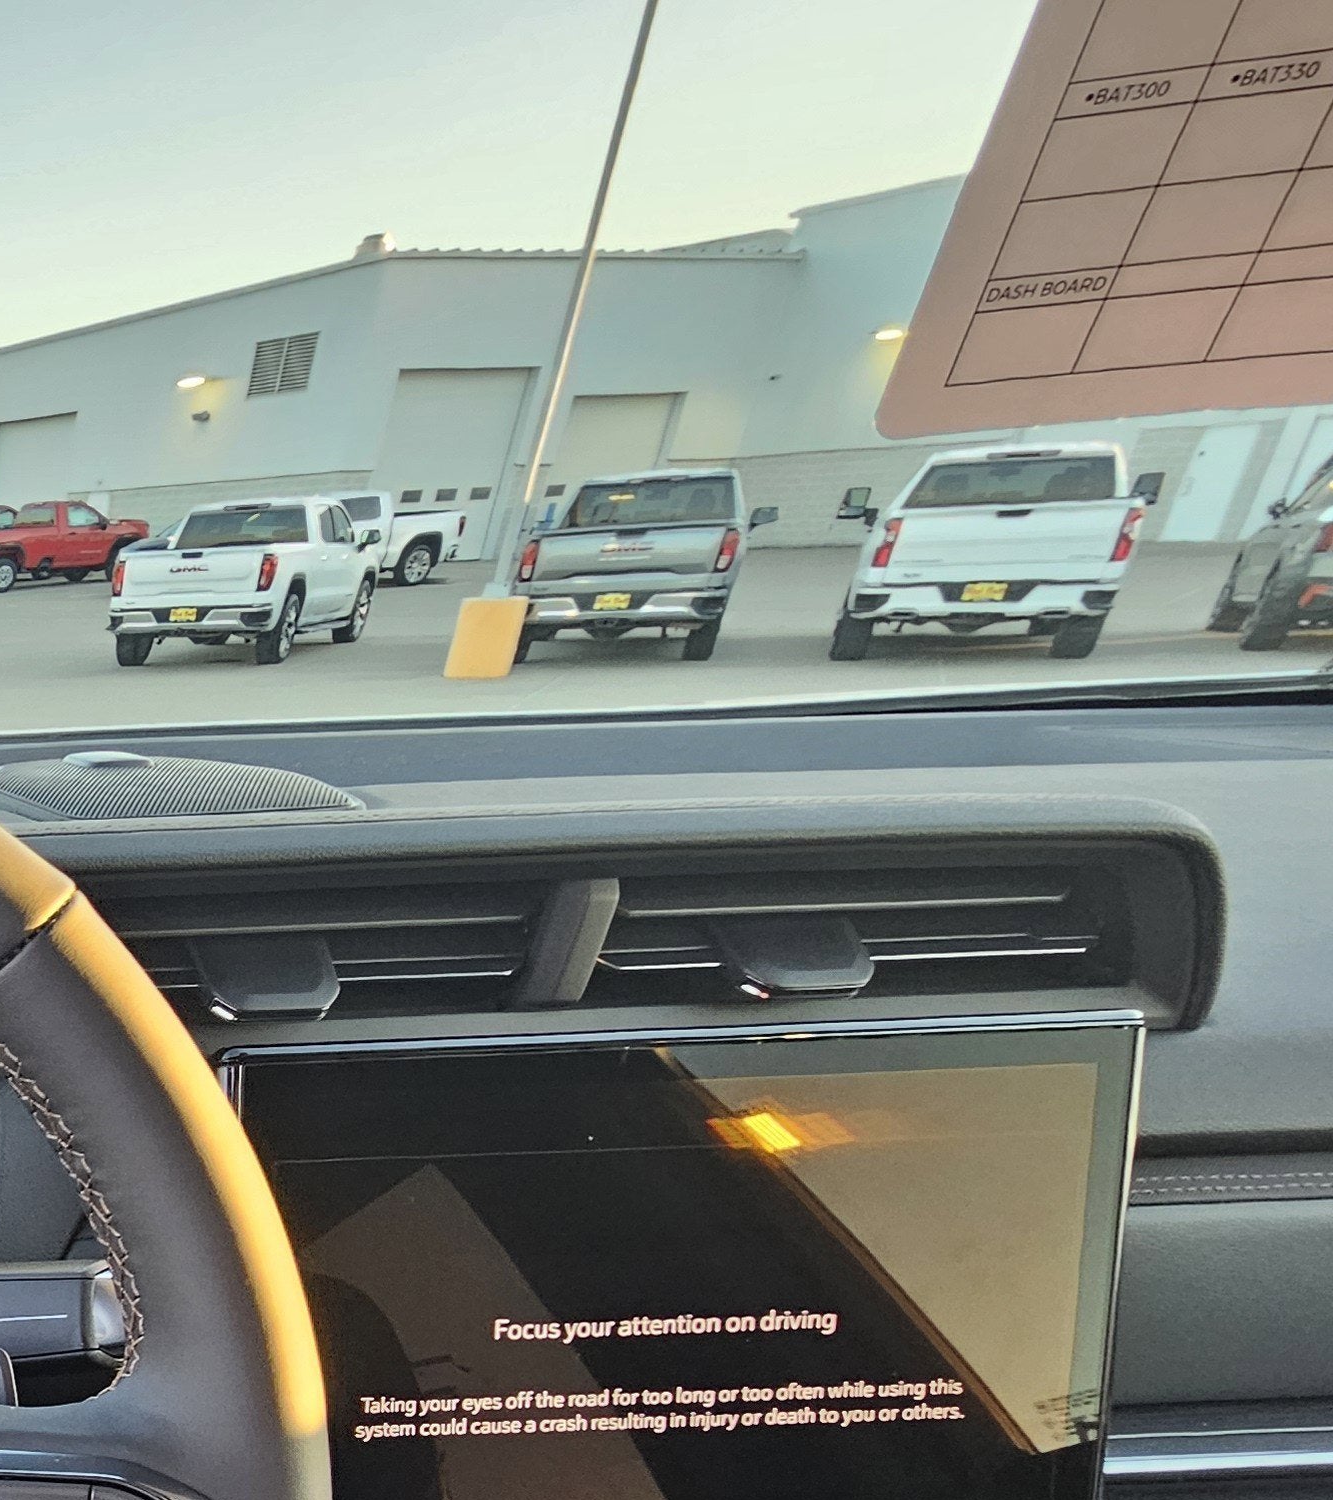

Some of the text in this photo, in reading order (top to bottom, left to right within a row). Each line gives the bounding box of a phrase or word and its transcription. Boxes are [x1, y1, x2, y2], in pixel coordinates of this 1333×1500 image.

[1238, 60, 1322, 87] BAT330
[1093, 80, 1171, 105] BAT300
[985, 276, 1107, 303] DASH BOARD
[493, 1309, 838, 1344] Focus your attention on driving
[360, 1378, 963, 1417] Taking your eyes off the road for too long or too often while using this
[354, 1403, 966, 1443] system could cause a crash resulting in injury or death to you or others.
